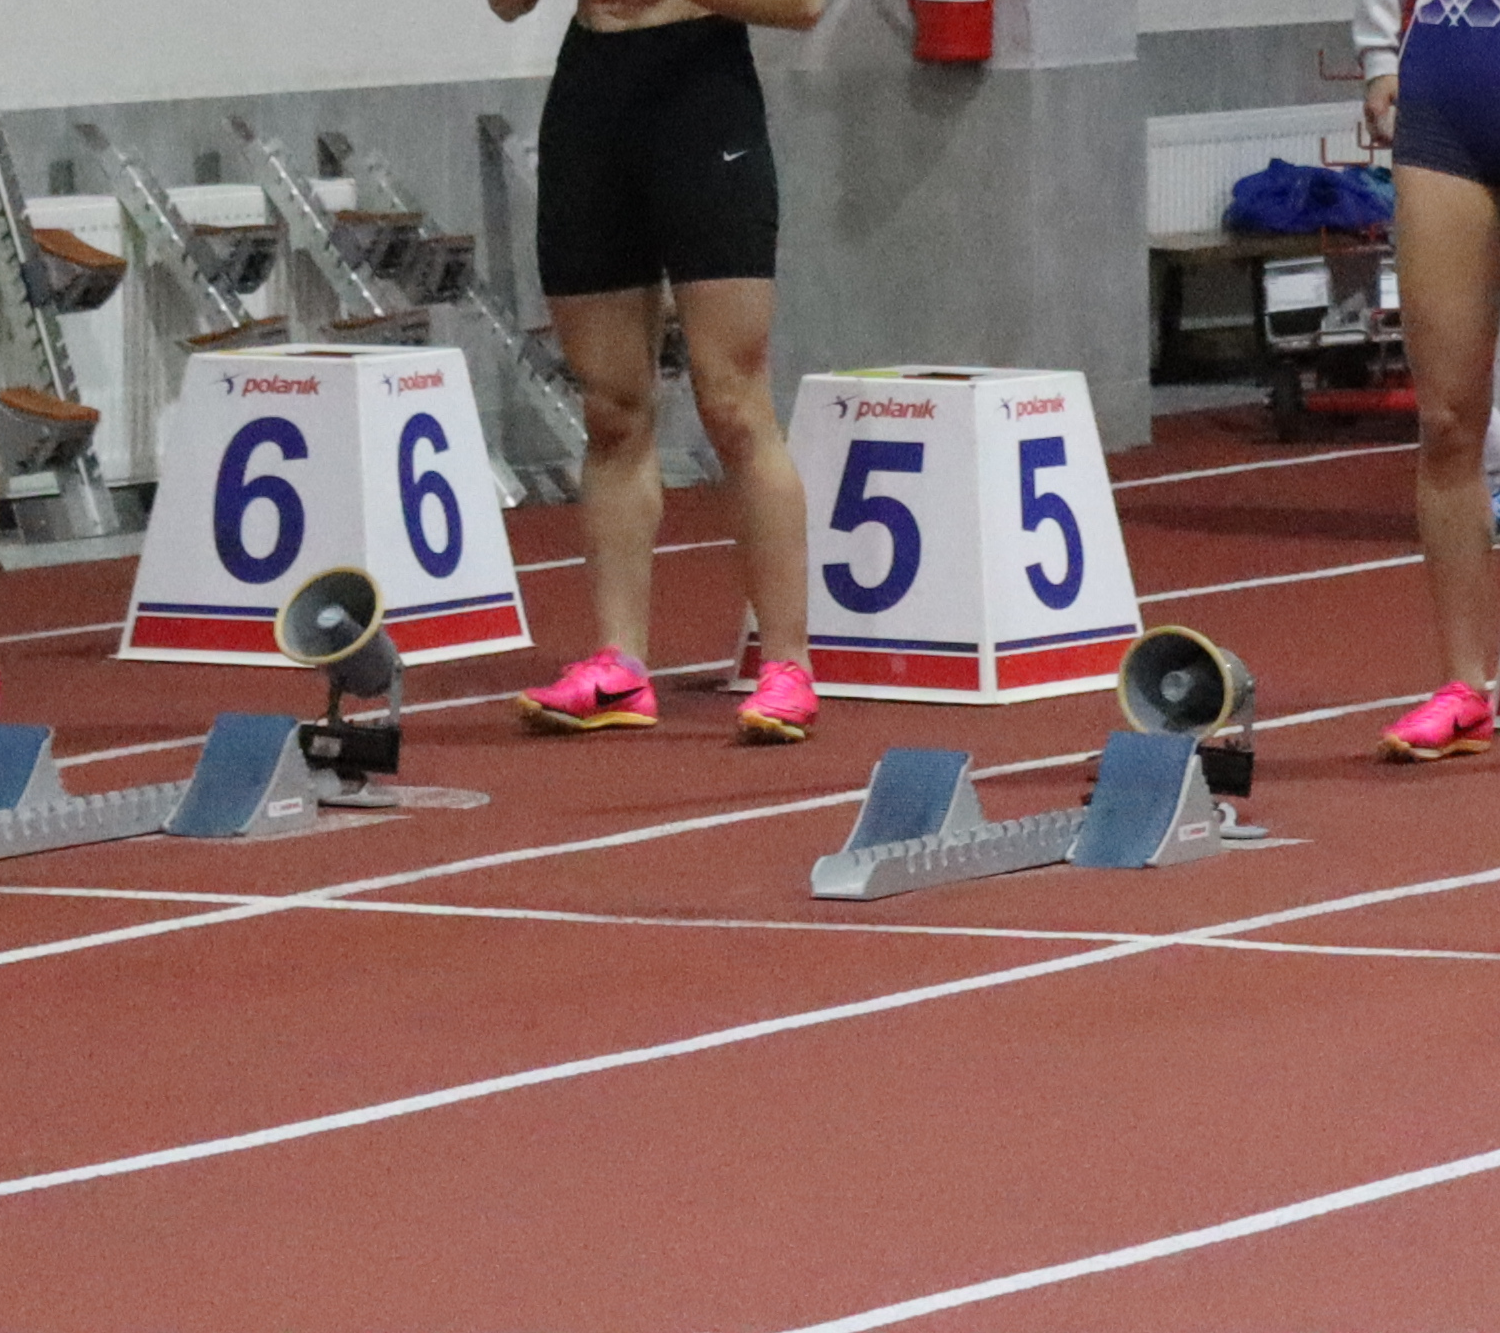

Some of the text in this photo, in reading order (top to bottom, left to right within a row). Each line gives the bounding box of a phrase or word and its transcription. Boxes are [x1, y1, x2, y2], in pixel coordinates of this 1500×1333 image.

[242, 373, 322, 397] polanik
[855, 397, 938, 421] polanik
[212, 416, 310, 585] 6
[396, 411, 464, 580] 6
[821, 440, 925, 614] 5
[1018, 436, 1085, 611] 5
